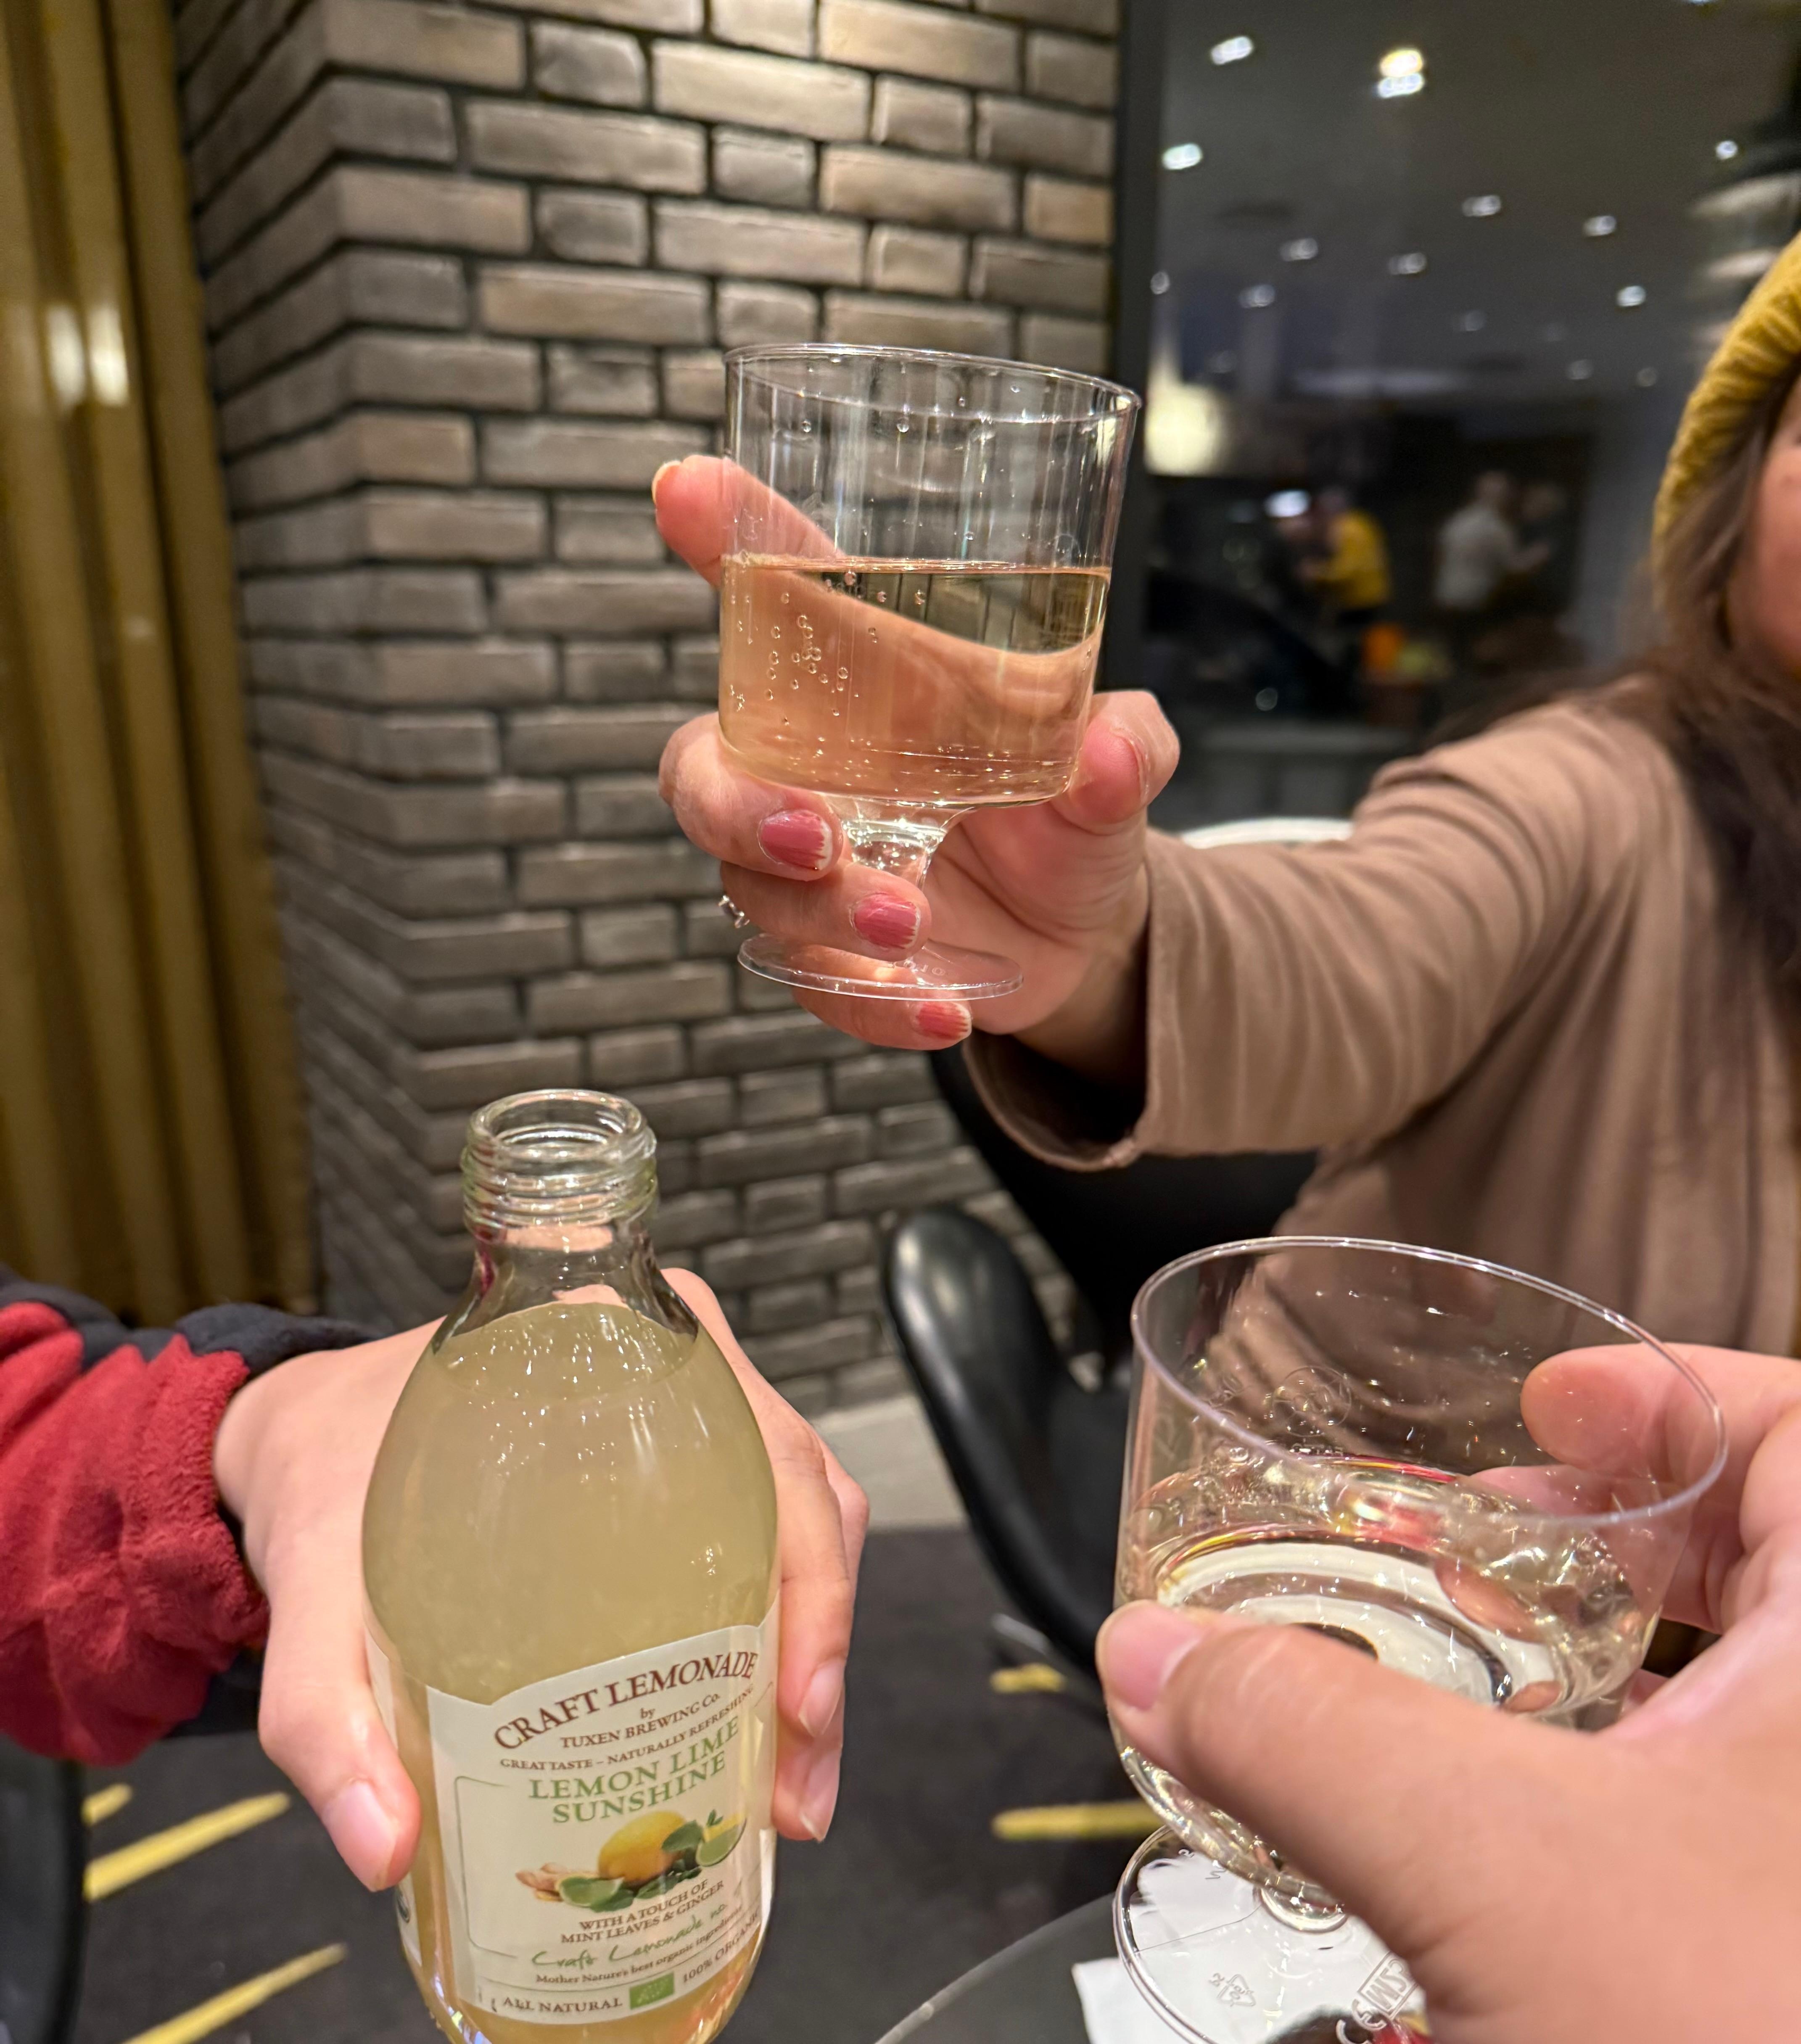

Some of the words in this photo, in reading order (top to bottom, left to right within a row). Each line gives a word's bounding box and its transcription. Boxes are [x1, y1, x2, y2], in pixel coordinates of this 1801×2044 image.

[494, 1689, 600, 1749] CRAFT
[605, 1651, 758, 1707] LEMONADE
[560, 1730, 621, 1748] TUXEN
[625, 1701, 700, 1738] BREWING
[640, 1707, 655, 1719] by
[500, 1758, 546, 1770] GREAT
[547, 1759, 593, 1770] TASTE
[607, 1730, 687, 1764] NATURALLY
[528, 1761, 660, 1799] LEMON
[669, 1715, 739, 1774] LIME
[552, 1750, 726, 1824] SUNSHINE
[561, 1931, 603, 1944] MINT
[606, 1915, 660, 1939] LEAVES
[663, 1912, 675, 1922] &
[676, 1880, 724, 1914] GINGER
[578, 1915, 623, 1931] WITH
[626, 1912, 637, 1923] A
[638, 1892, 689, 1920] TOUCH
[691, 1878, 708, 1896] OF
[531, 1949, 597, 1970] Craft
[608, 1914, 704, 1962] Lemonade
[536, 1973, 580, 1983] Mother
[631, 1961, 653, 1974] best
[655, 1944, 694, 1965] organic
[682, 1959, 713, 1983] 100%
[502, 1997, 535, 2011] ALL
[538, 1997, 623, 2013] NATURAL
